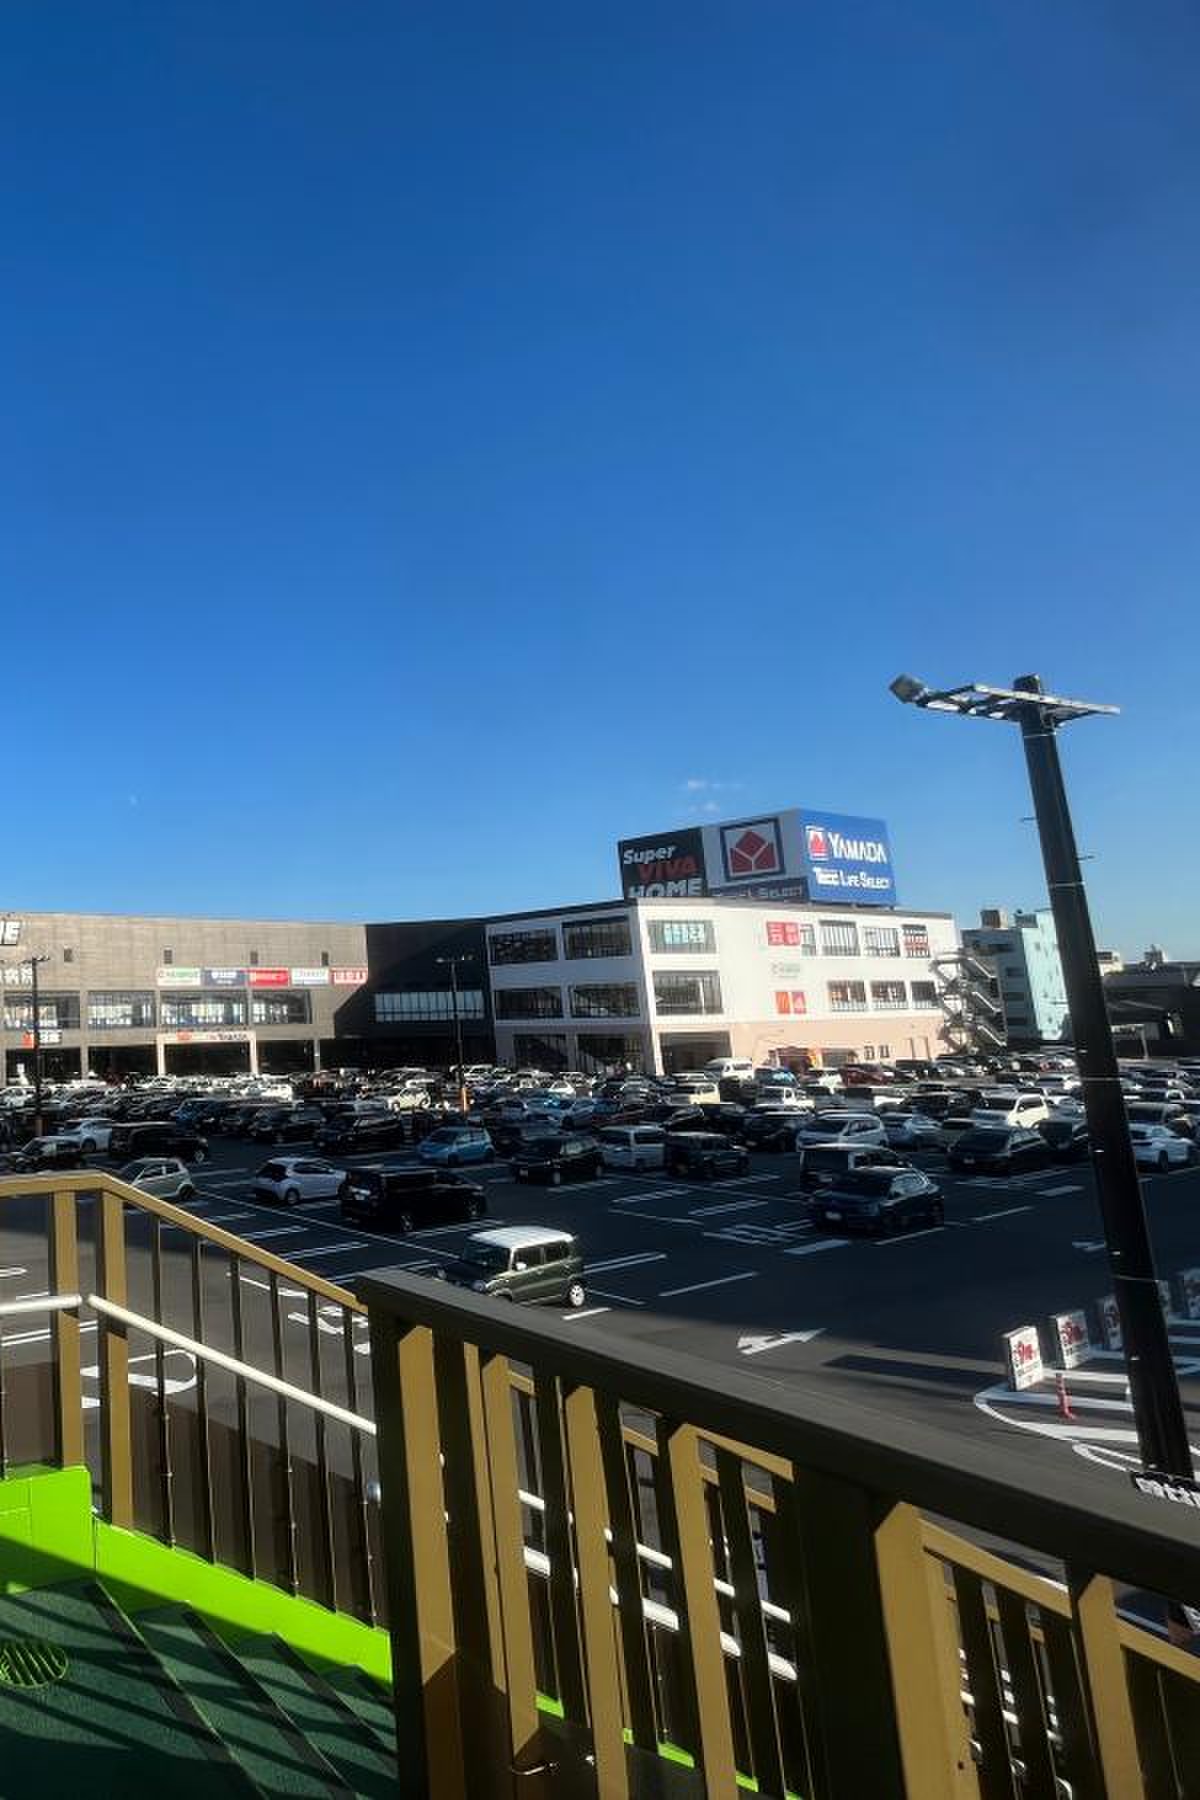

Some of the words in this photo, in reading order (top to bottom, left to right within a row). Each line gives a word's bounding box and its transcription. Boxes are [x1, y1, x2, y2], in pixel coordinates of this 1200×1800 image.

[623, 845, 675, 864] Super
[828, 831, 887, 864] YAMADA
[629, 878, 701, 897] HOME
